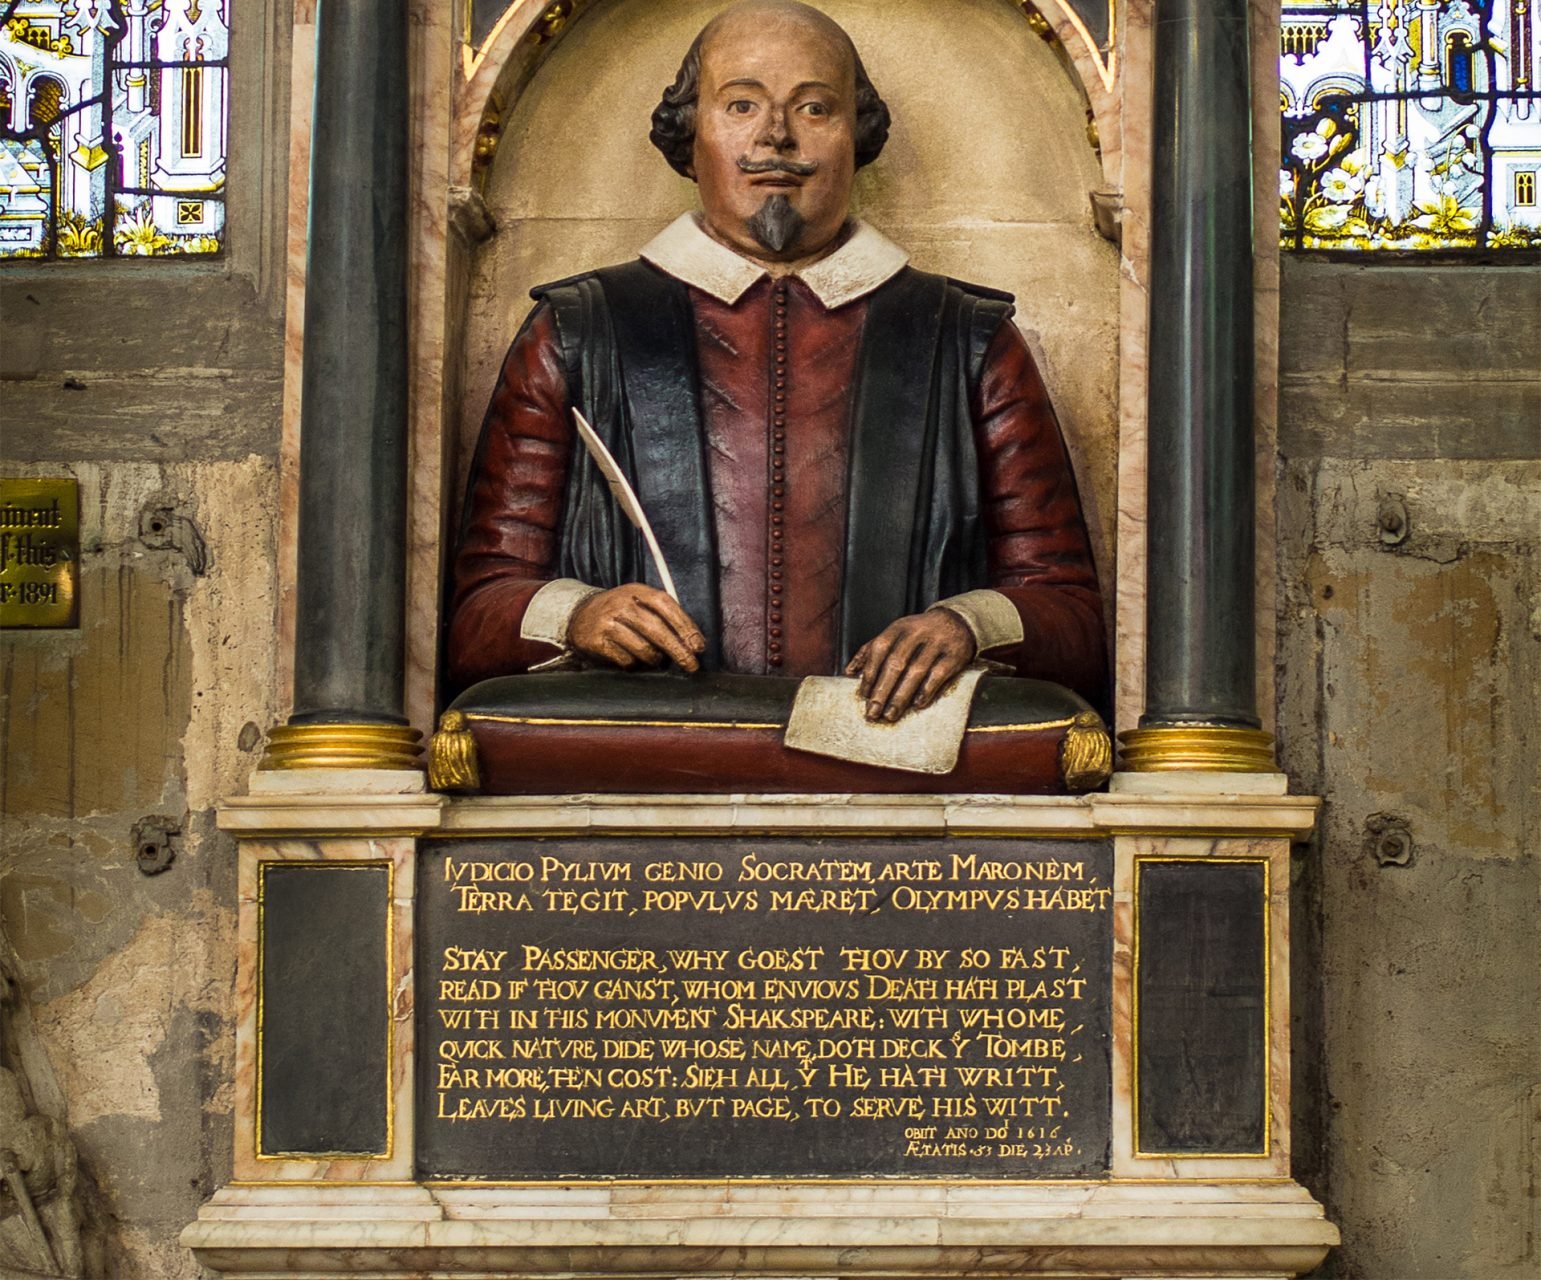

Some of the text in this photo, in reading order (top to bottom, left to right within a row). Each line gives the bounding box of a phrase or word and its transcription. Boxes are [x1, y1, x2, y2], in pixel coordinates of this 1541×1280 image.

[443, 856, 534, 883] IVDICIO
[540, 856, 631, 883] PYLIVM
[644, 861, 723, 882] GENIO
[877, 860, 943, 881] ARTE
[948, 854, 1097, 884] MARONEM,
[449, 883, 534, 915] TERRA
[541, 888, 638, 916] TEGIT,
[642, 889, 758, 914] POPVLVS
[892, 886, 1020, 913] OLYMPVS
[1024, 885, 1113, 914] HABET
[442, 945, 1080, 973] STAY PASSENGER, WHY GOEST THOV BY SO FAST,
[439, 979, 502, 1002] READ
[508, 978, 529, 1000] IF
[533, 978, 589, 1000] THOV
[681, 980, 757, 1000] WHOM
[763, 978, 859, 1003] ENVIOVS
[1005, 977, 1087, 1003] PLAST
[438, 1008, 499, 1030] WITH
[509, 1010, 539, 1029] IN
[543, 1007, 588, 1029] THIS
[723, 1002, 884, 1031] SHAKSPEARE:
[886, 1006, 948, 1029] WITH
[957, 1008, 1083, 1035] WHOME,
[439, 1040, 506, 1064] QVICK
[511, 1037, 598, 1061] NATVRE
[602, 1037, 655, 1061] DIDE
[659, 1037, 746, 1061] WHOSE
[815, 1037, 875, 1060] DOTH
[880, 1038, 947, 1059] DECK
[976, 1031, 1082, 1062] TOMBE,
[437, 1061, 481, 1089] FAR
[608, 1066, 677, 1088] COST:
[829, 1063, 871, 1090] HE
[954, 1065, 1065, 1092] WRITT,
[437, 1092, 1069, 1123] LEAVES LIVING ART, BVT PAGE, TO SERVE HIS WITT.
[1017, 1125, 1062, 1139] 1616
[997, 1143, 1028, 1158] DIE
